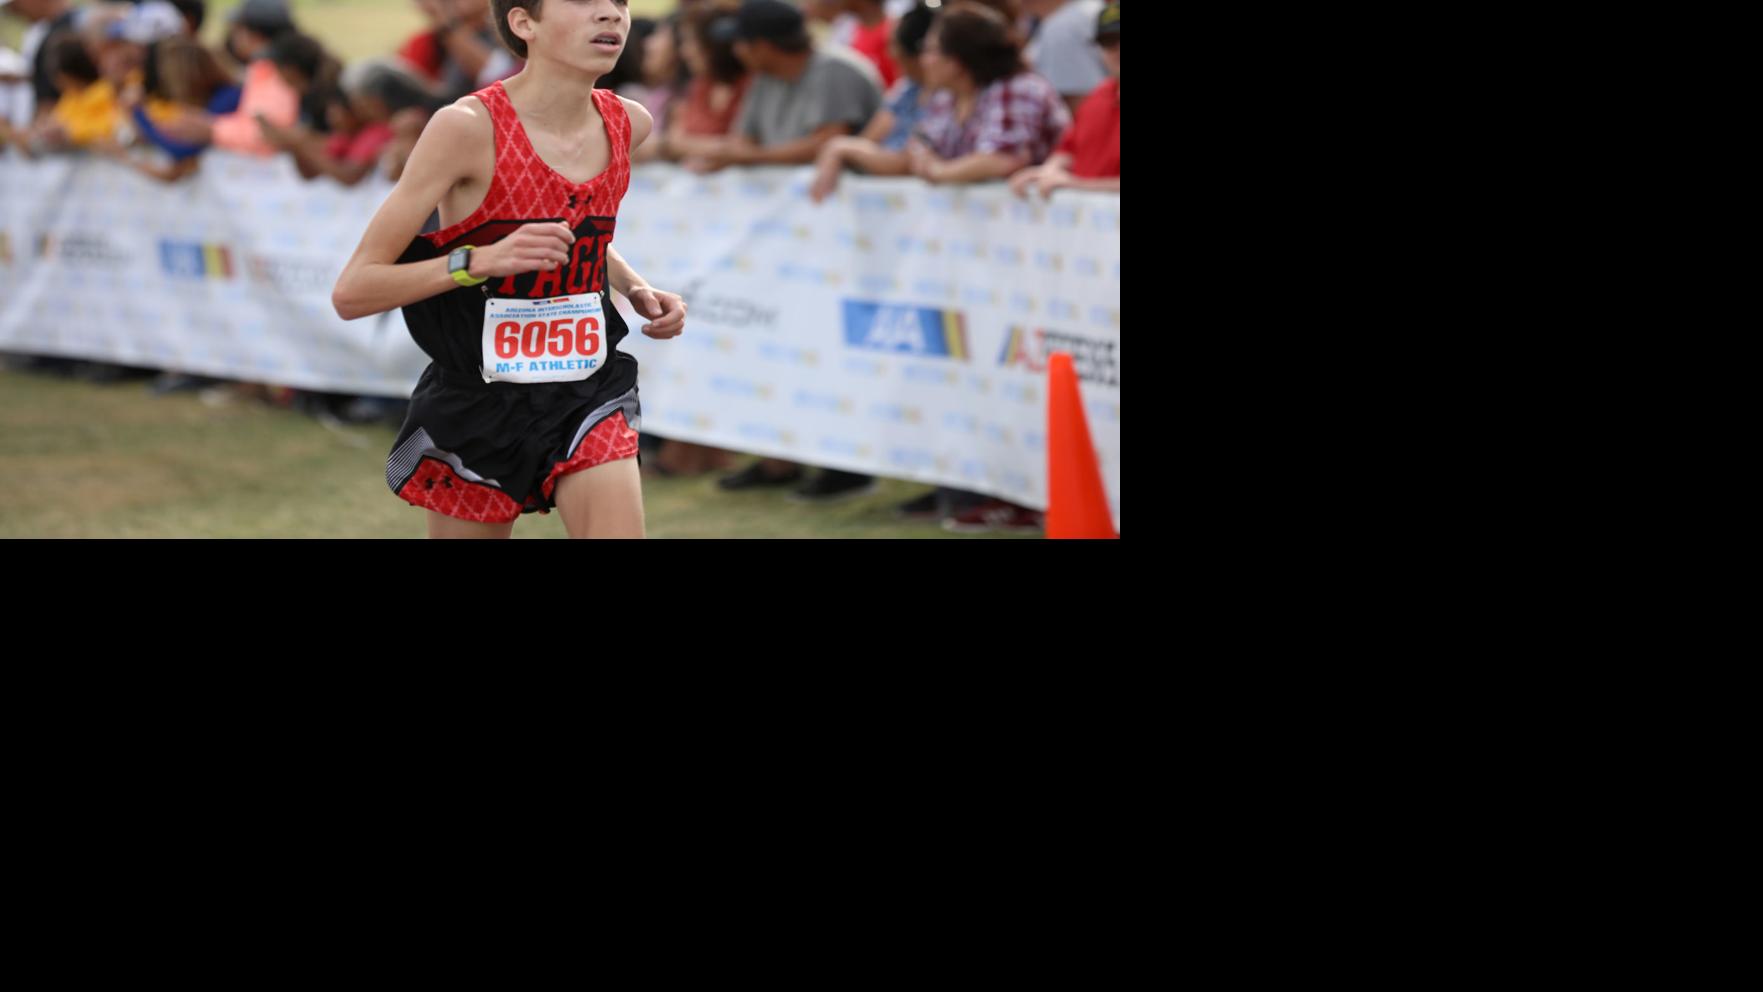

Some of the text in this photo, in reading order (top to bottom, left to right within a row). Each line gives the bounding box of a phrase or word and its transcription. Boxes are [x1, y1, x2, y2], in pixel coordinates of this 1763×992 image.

[494, 317, 600, 359] 6056
[496, 359, 597, 373] M-F ATHLETIC
